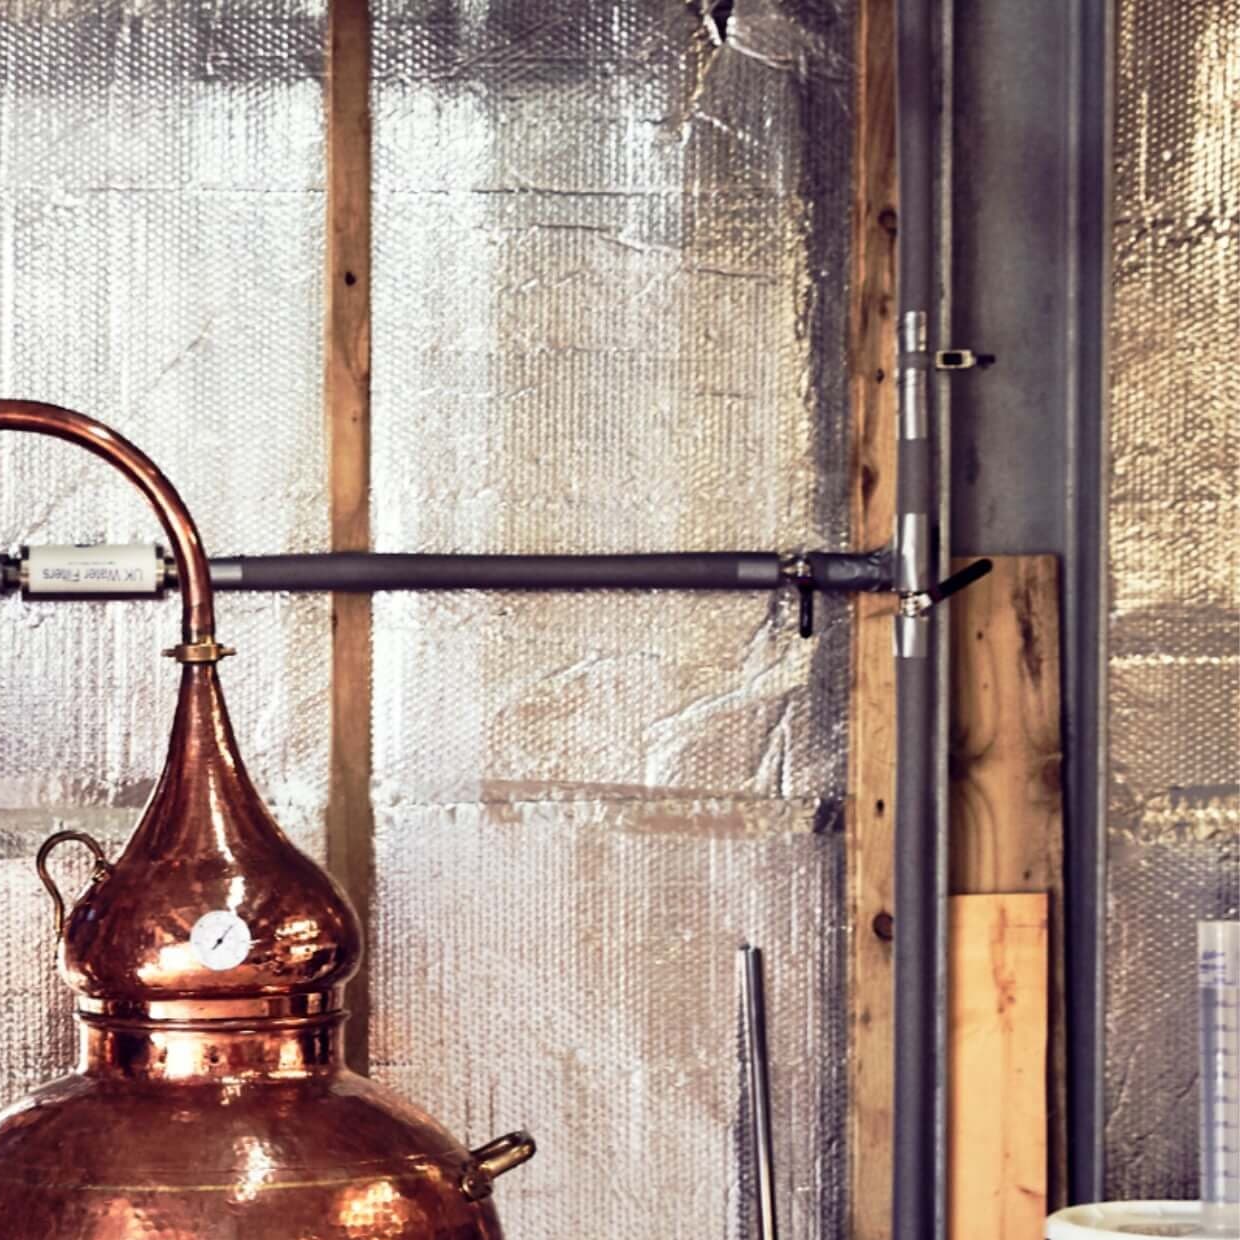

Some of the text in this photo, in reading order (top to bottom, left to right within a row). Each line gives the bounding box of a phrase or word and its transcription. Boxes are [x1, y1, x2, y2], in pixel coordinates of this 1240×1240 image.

[42, 568, 144, 582] UK Water Filters
